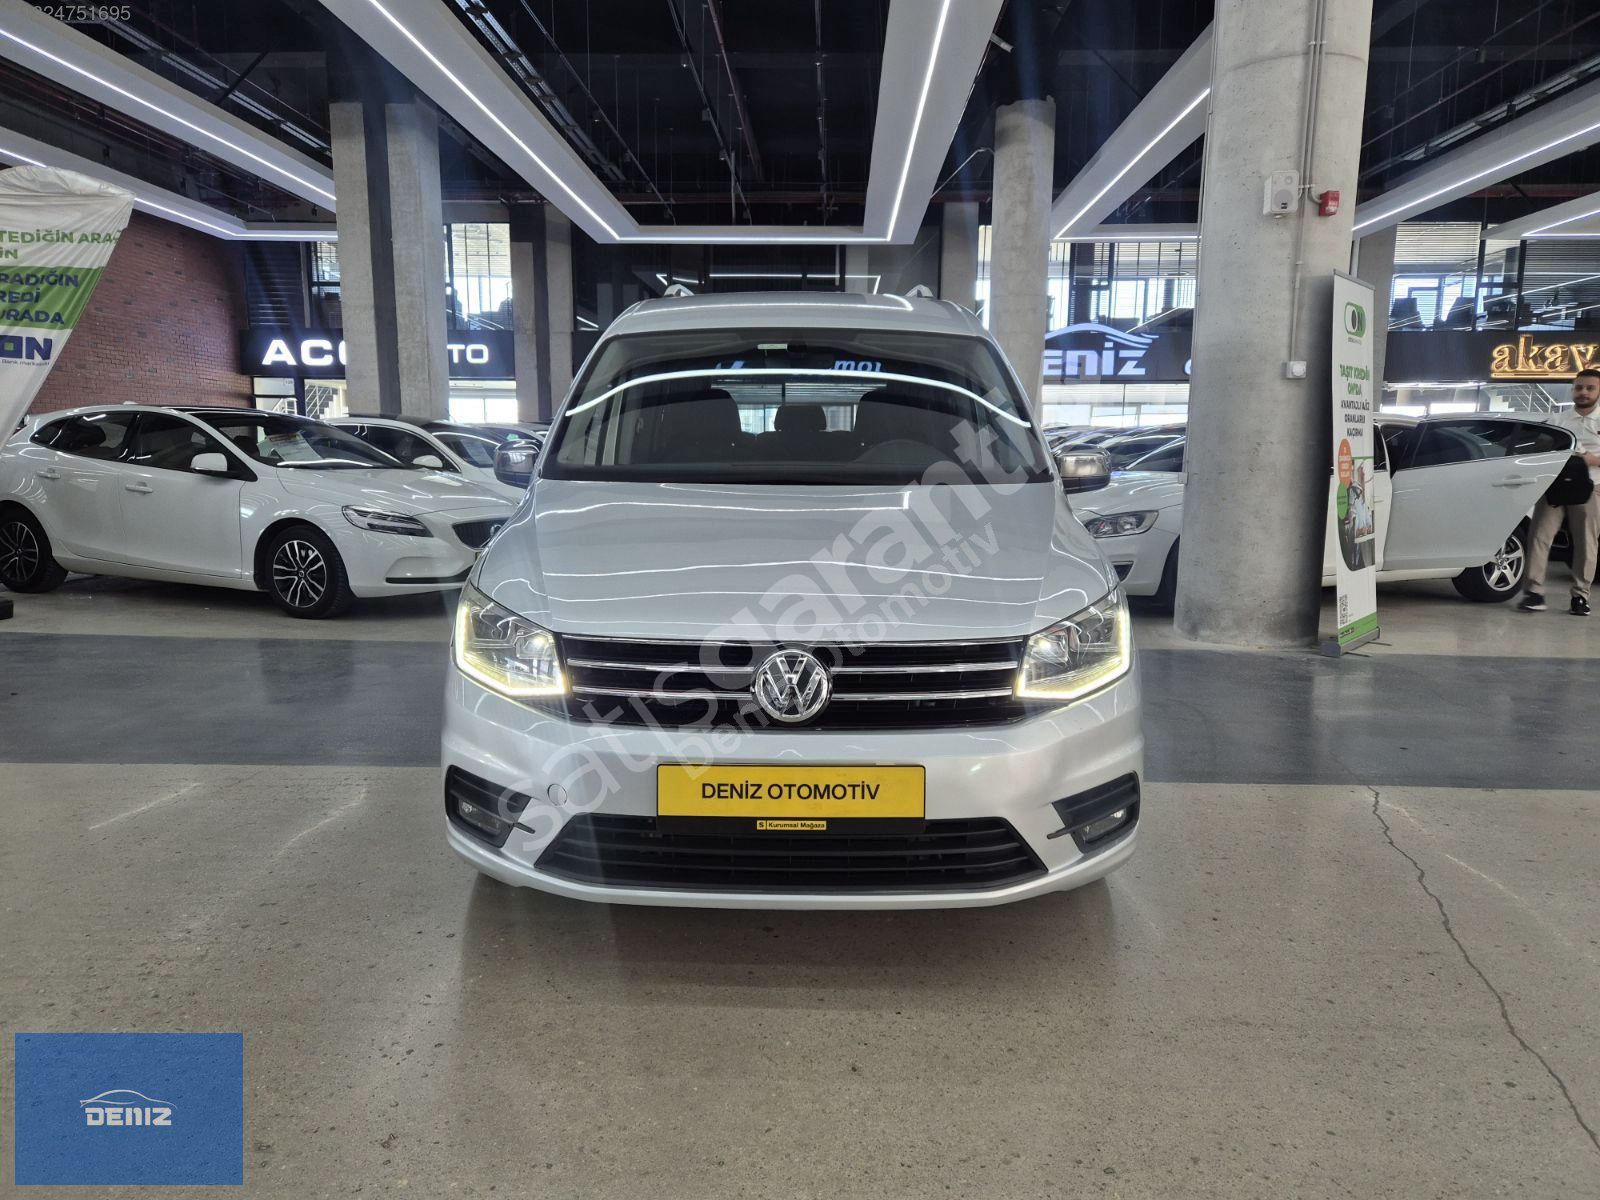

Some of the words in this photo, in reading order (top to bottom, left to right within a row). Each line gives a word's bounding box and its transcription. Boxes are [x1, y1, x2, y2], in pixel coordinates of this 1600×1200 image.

[446, 343, 489, 364] TO
[701, 780, 763, 800] DENİZ
[767, 780, 881, 800] OTOMOTİV
[800, 821, 825, 830] Mağaza
